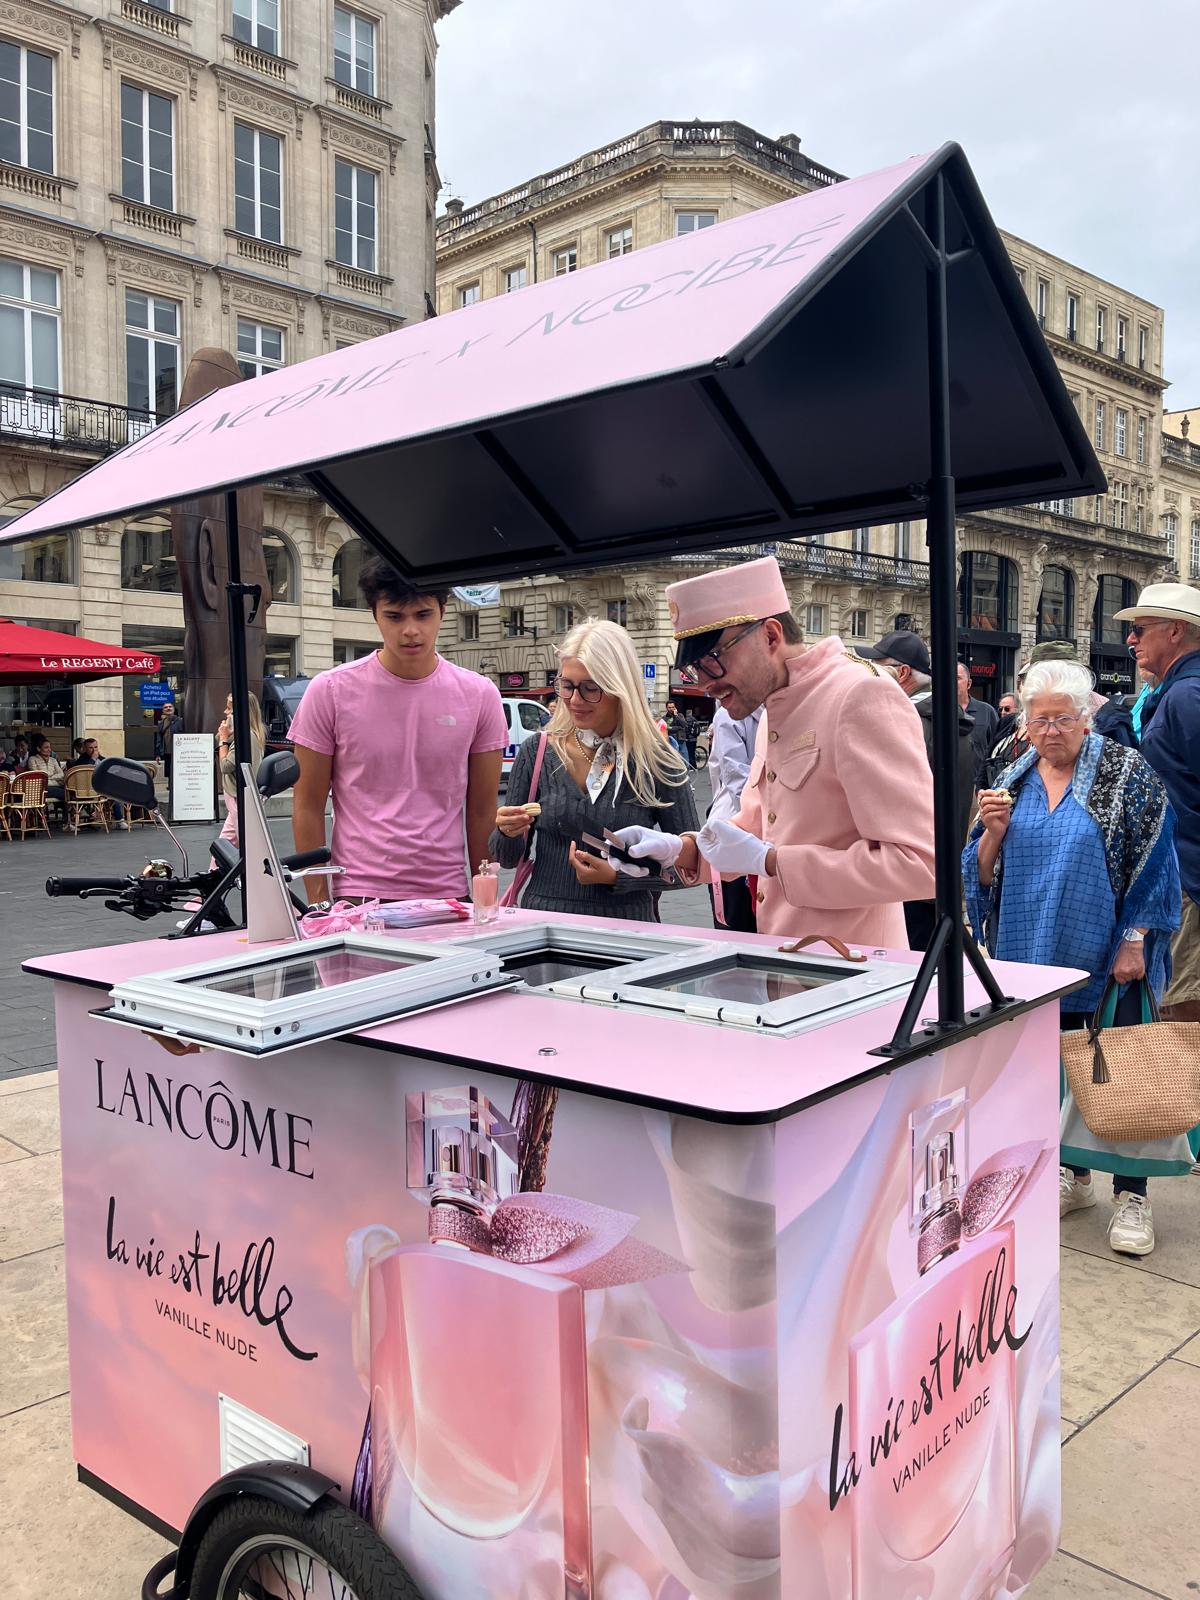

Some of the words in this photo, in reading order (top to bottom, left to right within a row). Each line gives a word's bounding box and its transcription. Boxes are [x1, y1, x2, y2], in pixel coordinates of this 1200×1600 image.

[40, 657, 58, 669] Le
[61, 657, 123, 670] REGENT
[125, 657, 154, 670] Café
[94, 1058, 315, 1180] LANCÔME
[213, 1116, 231, 1127] PARIS
[136, 1238, 165, 1277] vie
[169, 1230, 210, 1297] est
[212, 1236, 319, 1361] belle
[154, 1298, 212, 1340] VANILLE
[216, 1328, 258, 1363] NUDE
[870, 1396, 905, 1468] vie
[908, 1321, 952, 1429] est
[952, 1247, 1034, 1393] belle
[892, 1423, 951, 1494] VANILLE
[955, 1386, 991, 1433] NUDE
